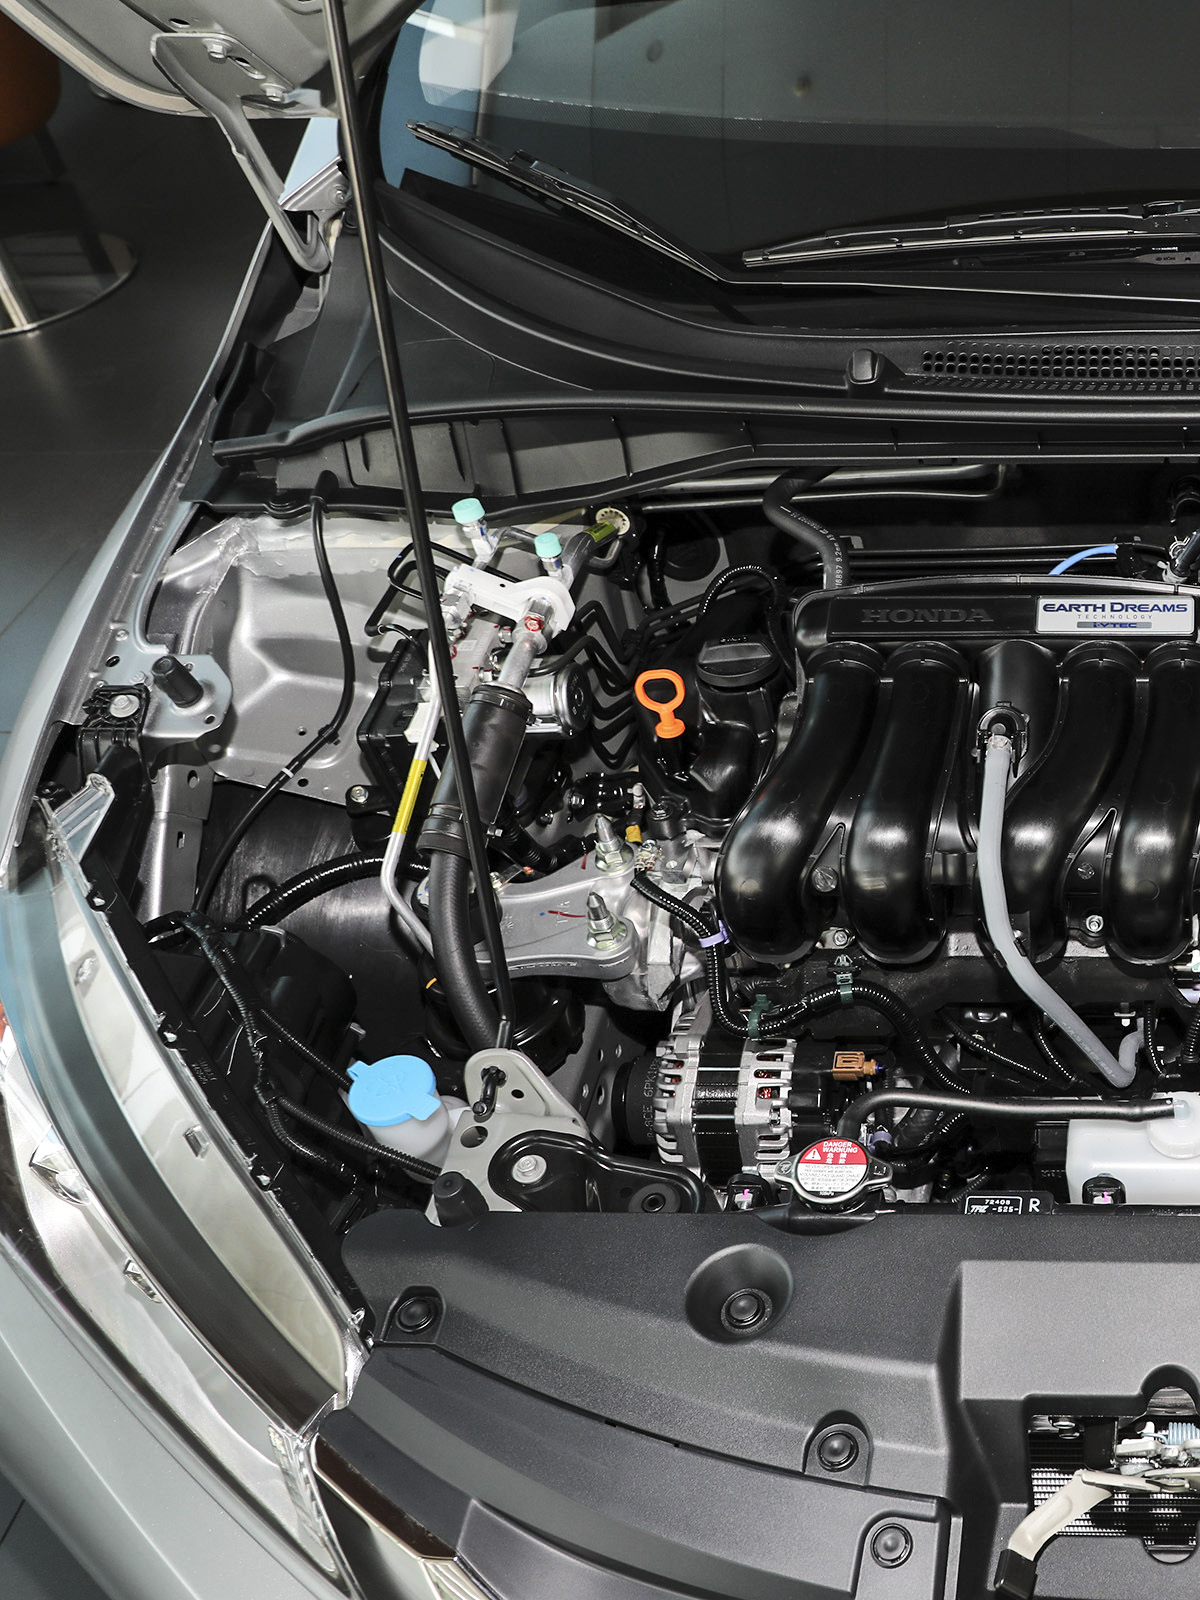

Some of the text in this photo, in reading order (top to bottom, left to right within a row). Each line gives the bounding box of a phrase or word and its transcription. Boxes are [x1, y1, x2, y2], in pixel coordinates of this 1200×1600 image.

[835, 565, 843, 587] 16897
[1042, 602, 1188, 613] EARTH DREAMS
[861, 608, 994, 623] HONDA
[1028, 1197, 1041, 1213] R
